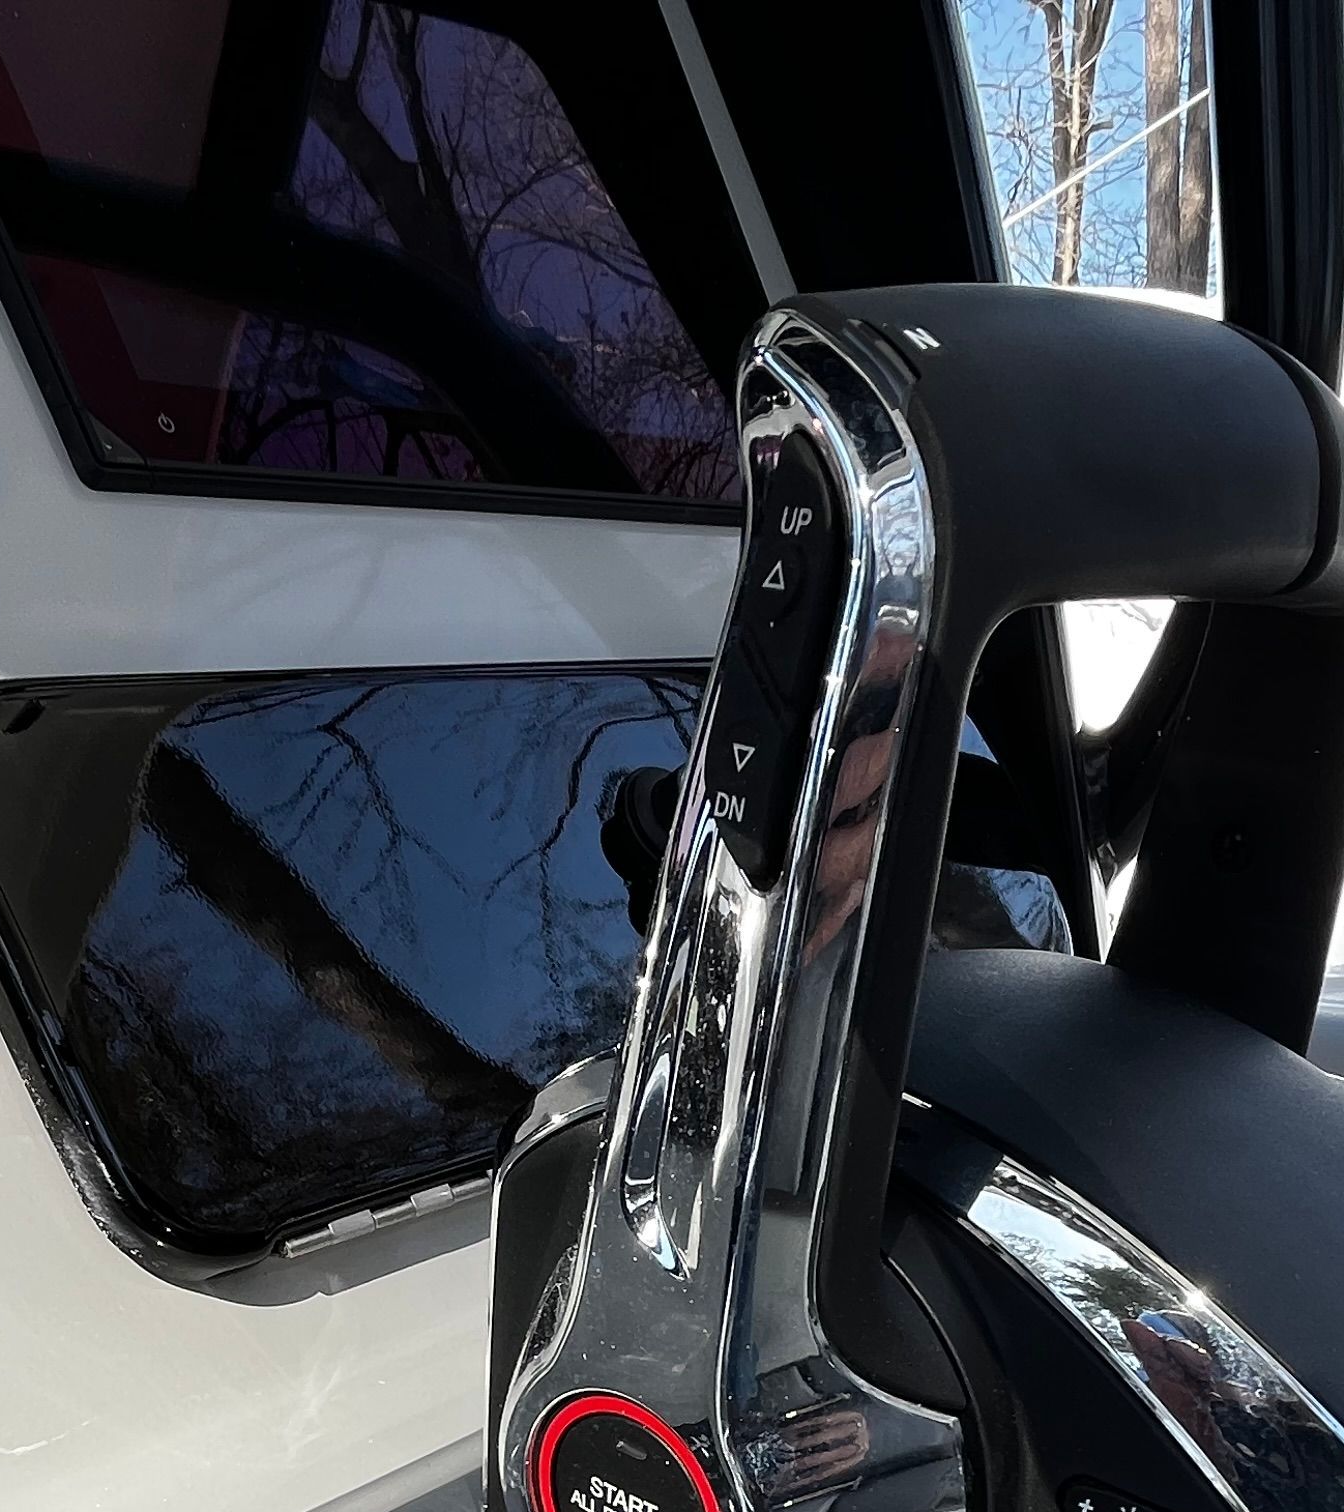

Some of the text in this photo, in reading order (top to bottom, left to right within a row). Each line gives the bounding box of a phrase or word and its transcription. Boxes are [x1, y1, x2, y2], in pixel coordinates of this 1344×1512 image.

[902, 327, 941, 350] N
[780, 506, 813, 535] UP
[714, 791, 745, 823] DN
